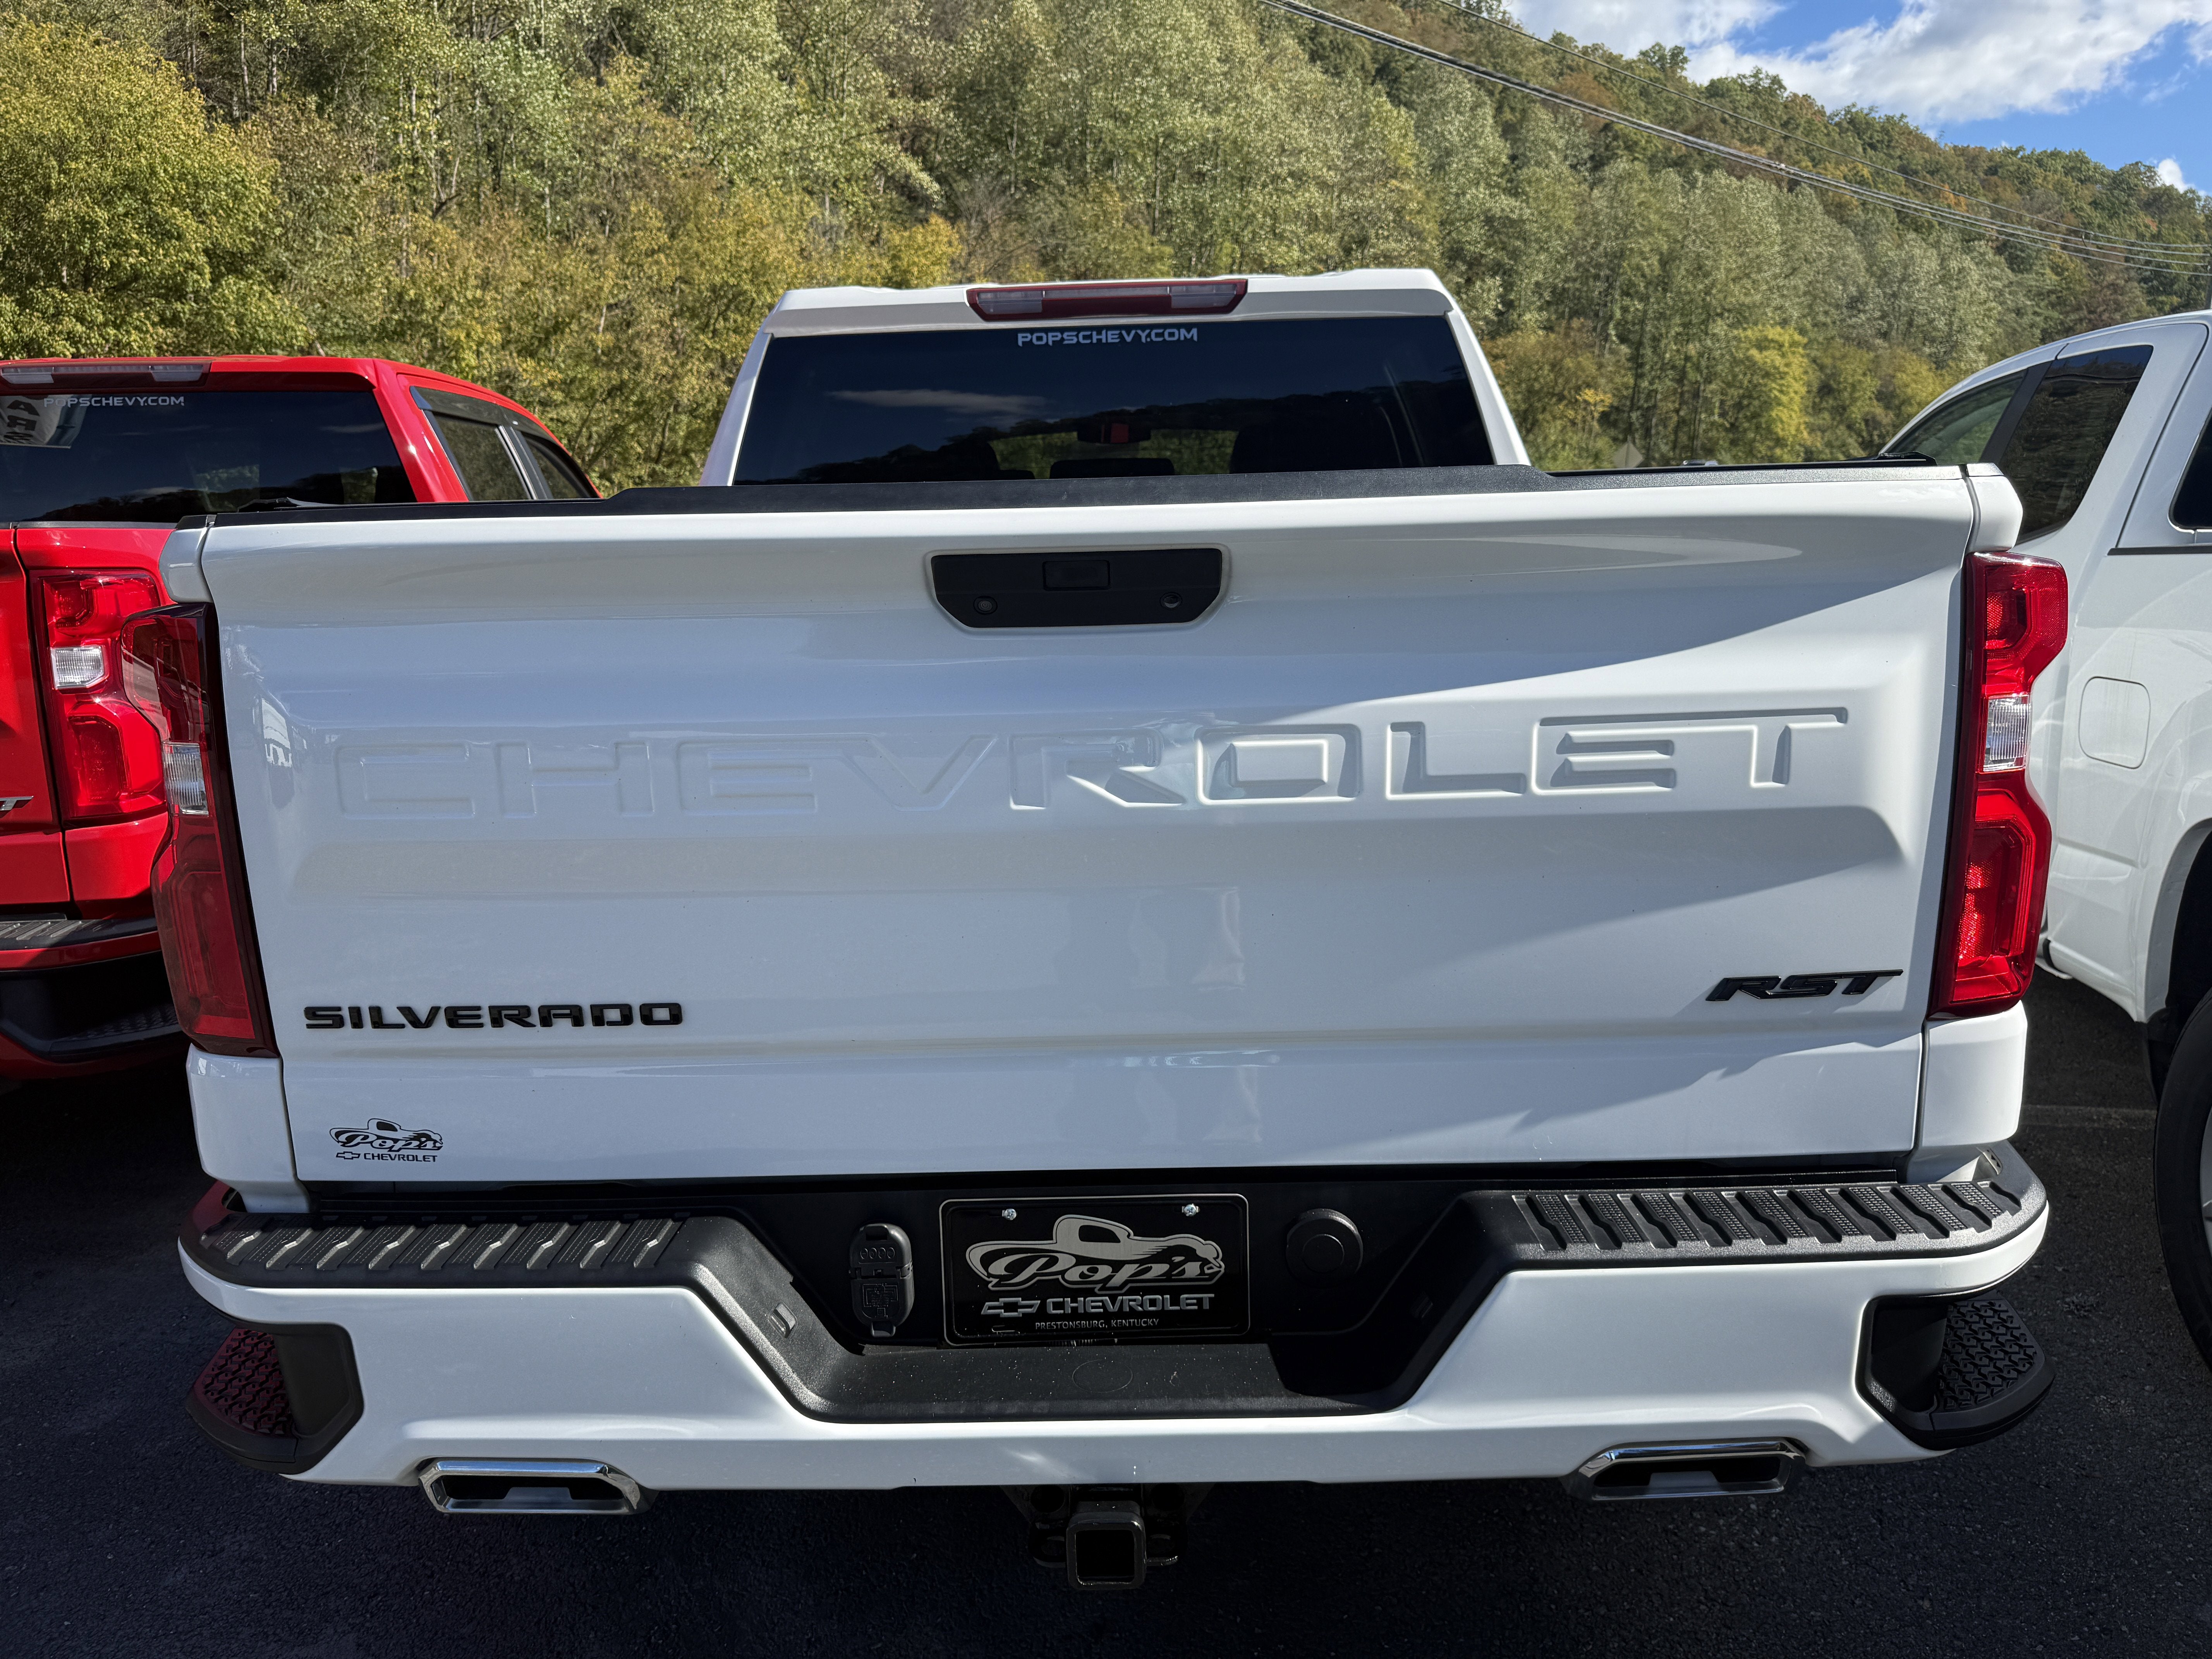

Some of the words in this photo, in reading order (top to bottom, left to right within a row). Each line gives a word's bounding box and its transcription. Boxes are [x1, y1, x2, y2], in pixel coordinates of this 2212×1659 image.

[1018, 328, 1198, 346] POPSCHEVY.COM
[44, 396, 184, 408] POPSCHEVY.COM
[334, 708, 1847, 819] CHEVROLET
[1705, 969, 1903, 1001] RST
[304, 1003, 683, 1029] SILVERADO
[364, 1153, 438, 1162] CHEVROLET
[1046, 1294, 1215, 1314] CHEVROLET
[1036, 1320, 1108, 1329] PRESTONSBURG,
[1111, 1319, 1159, 1328] KENTUCKY
